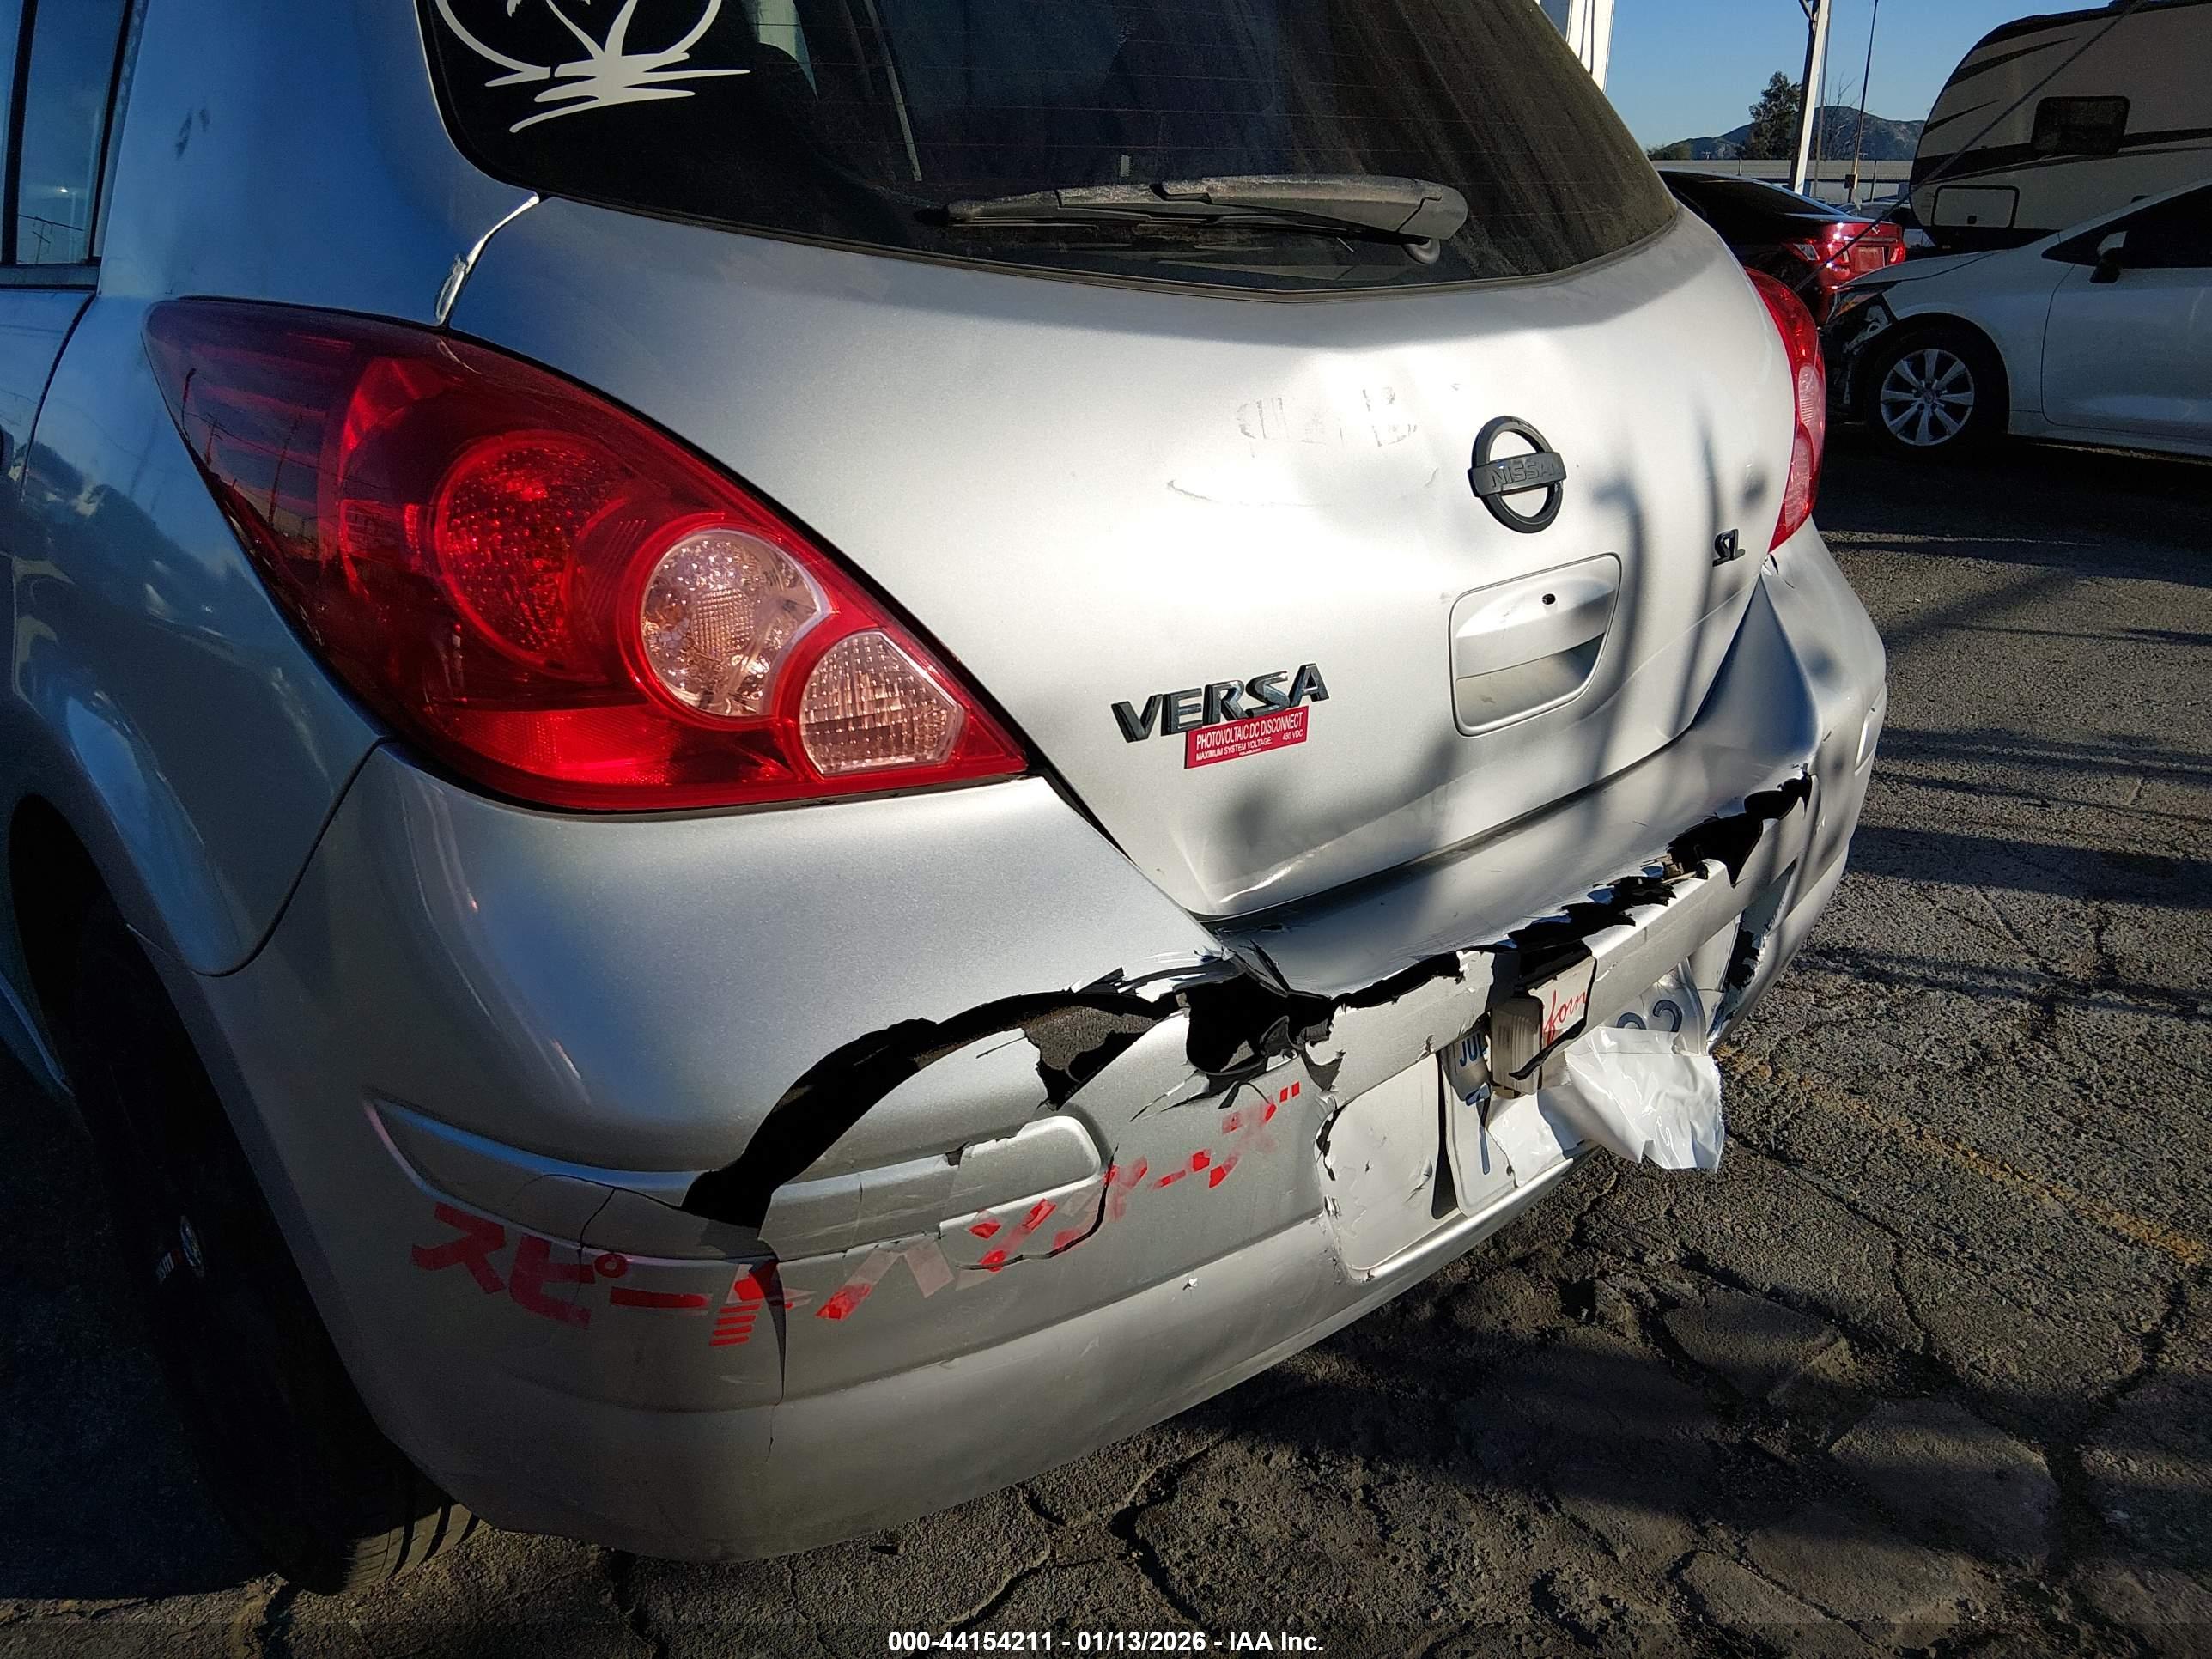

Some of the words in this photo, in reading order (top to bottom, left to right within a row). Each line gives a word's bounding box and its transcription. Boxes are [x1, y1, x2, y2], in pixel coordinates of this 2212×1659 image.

[1712, 529, 1745, 567] SL
[1111, 663, 1330, 743] VERSA
[1196, 724, 1249, 751] PHOTOVOLTAIC
[1249, 721, 1260, 739] DC
[1261, 711, 1304, 736] DISCONNECT
[1195, 748, 1223, 762] MAXIMUM
[1224, 742, 1246, 756] SYSTEM
